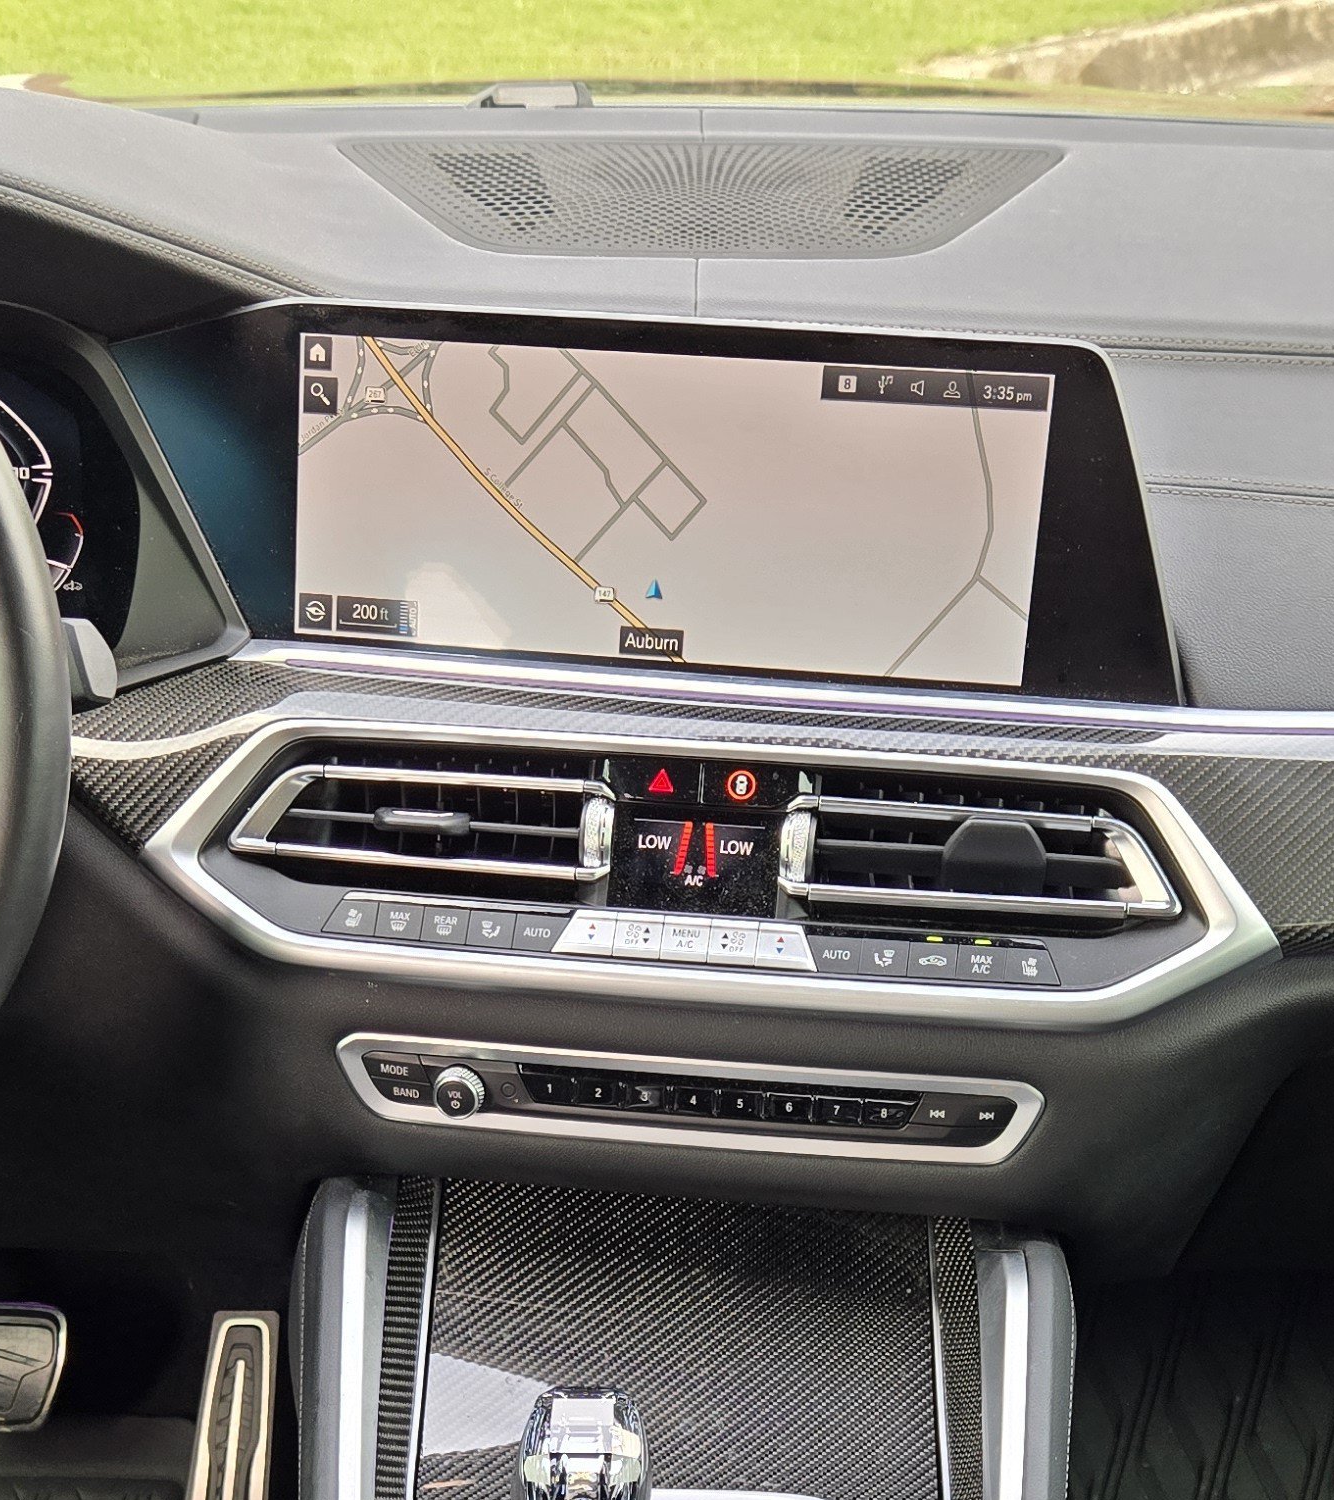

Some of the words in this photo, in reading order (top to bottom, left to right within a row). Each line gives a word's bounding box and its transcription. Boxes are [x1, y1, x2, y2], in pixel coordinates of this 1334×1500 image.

[843, 378, 851, 390] 8
[369, 389, 381, 398] 267
[983, 385, 1015, 401] 3:35
[1016, 392, 1032, 402] pm
[301, 422, 324, 442] Jordan
[490, 474, 515, 498] College
[599, 590, 611, 598] 147
[352, 604, 378, 620] 200
[379, 608, 389, 620] ft
[624, 632, 678, 651] Auburn
[638, 834, 672, 850] LOW
[719, 840, 754, 856] LOW
[684, 875, 703, 887] A/C
[390, 911, 410, 921] MAX
[434, 915, 458, 926] REAR
[523, 927, 551, 938] AUTO
[672, 928, 700, 938] MENU
[676, 939, 694, 949] A/C
[822, 950, 851, 961] AUTO
[971, 955, 994, 965] MAX
[972, 965, 991, 975] A/C
[380, 1063, 409, 1077] MODE
[393, 1086, 420, 1099] BAND
[546, 1083, 552, 1094] 1
[595, 1087, 602, 1098] 2
[447, 1090, 463, 1099] VOL
[690, 1095, 697, 1105] 4
[736, 1098, 744, 1109] 5
[785, 1102, 793, 1112] 6
[833, 1105, 841, 1116] 7
